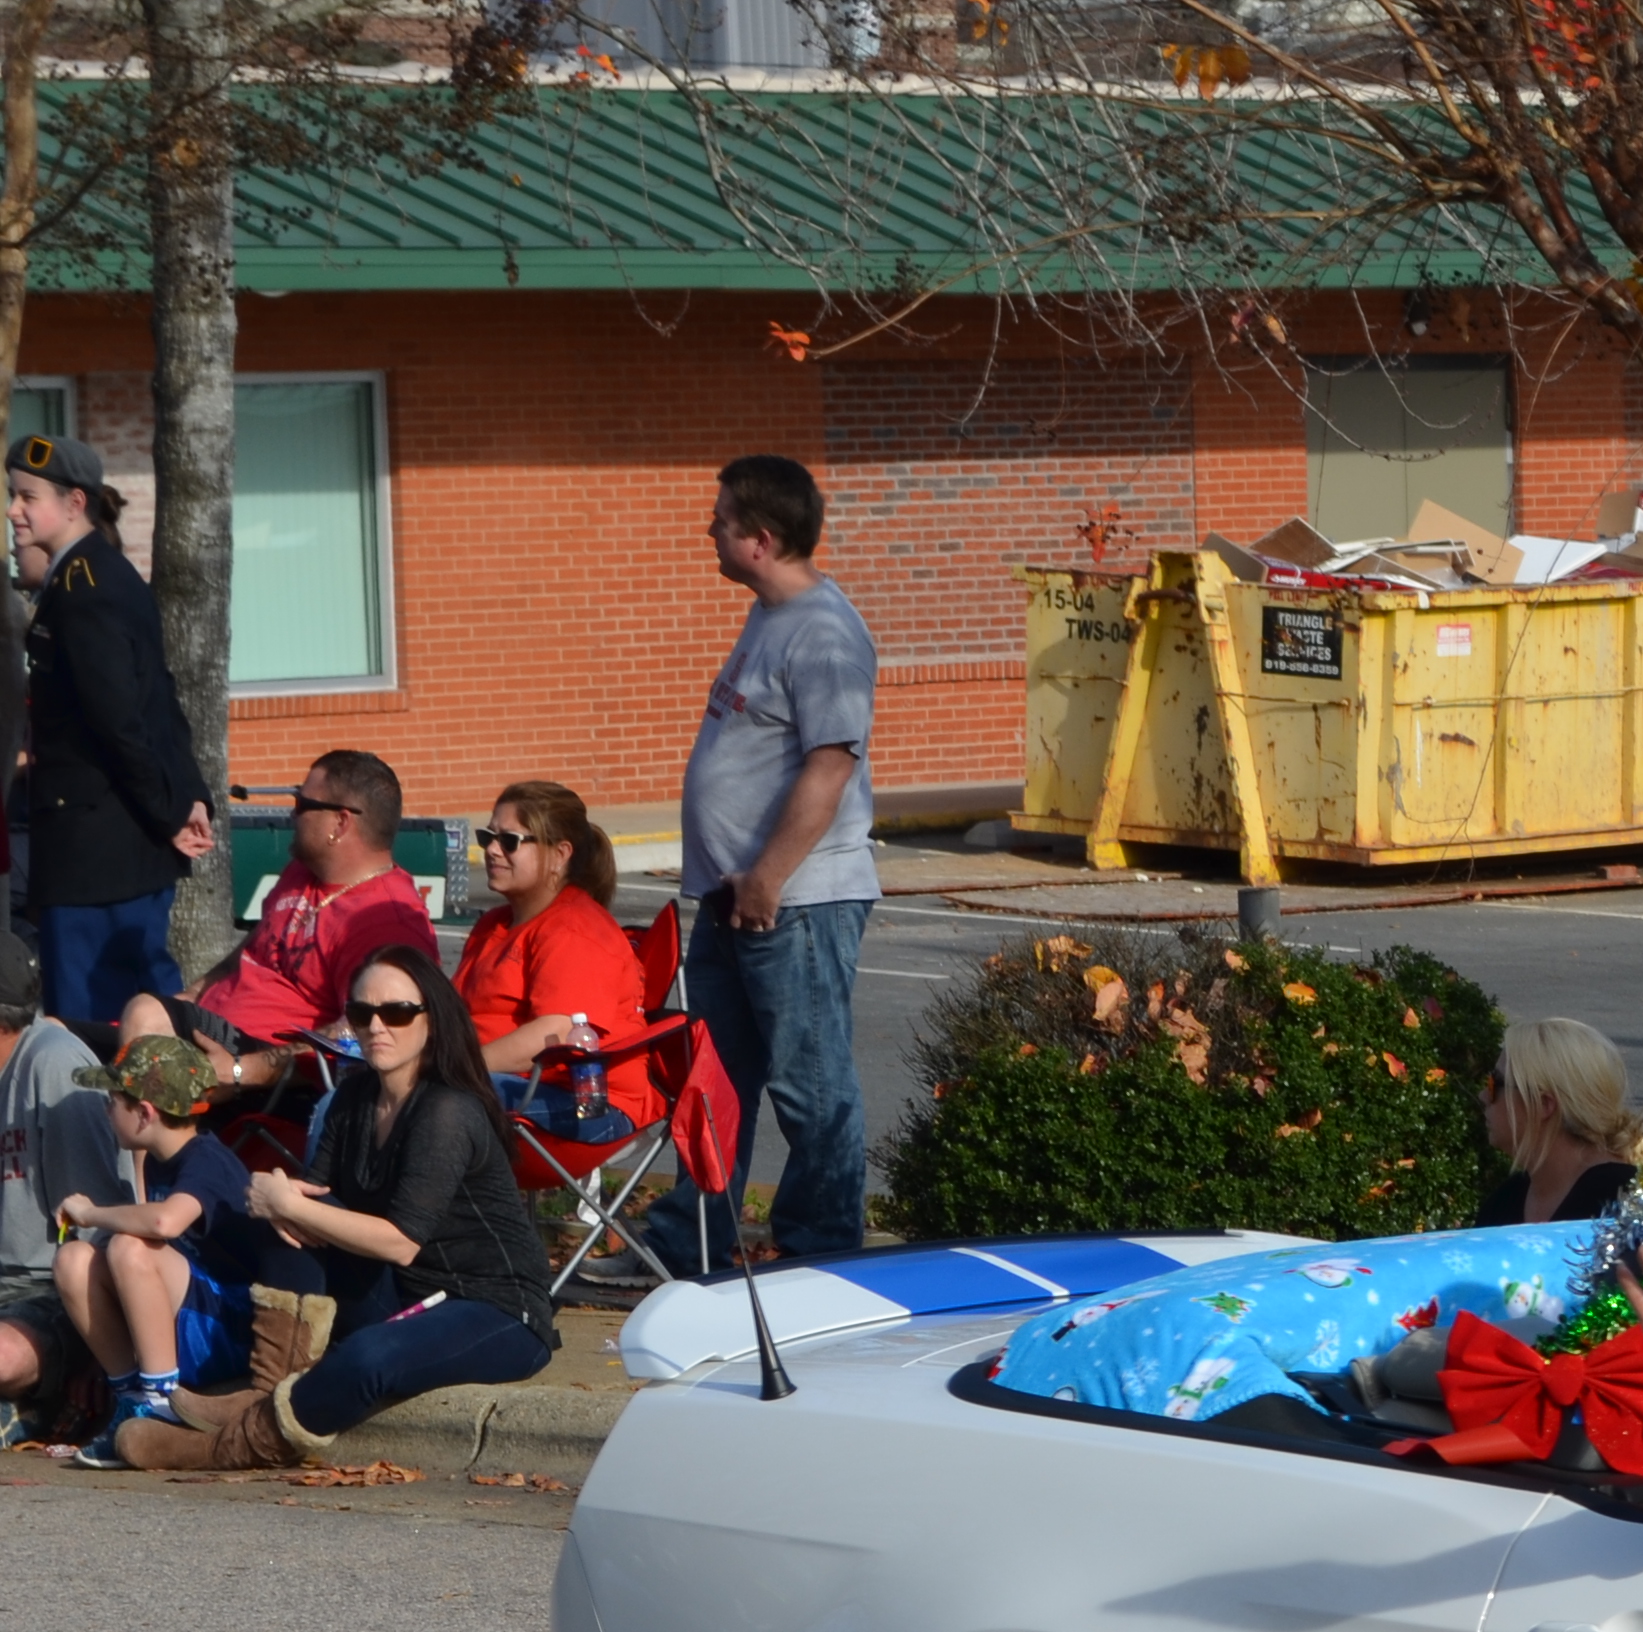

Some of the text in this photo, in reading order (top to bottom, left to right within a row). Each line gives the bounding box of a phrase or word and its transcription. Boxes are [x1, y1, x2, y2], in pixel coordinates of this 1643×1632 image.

[1043, 589, 1096, 613] 15-04
[1064, 617, 1131, 643] TWS-04
[1277, 611, 1334, 631] TRIANGLE
[1276, 643, 1332, 662] SEICES
